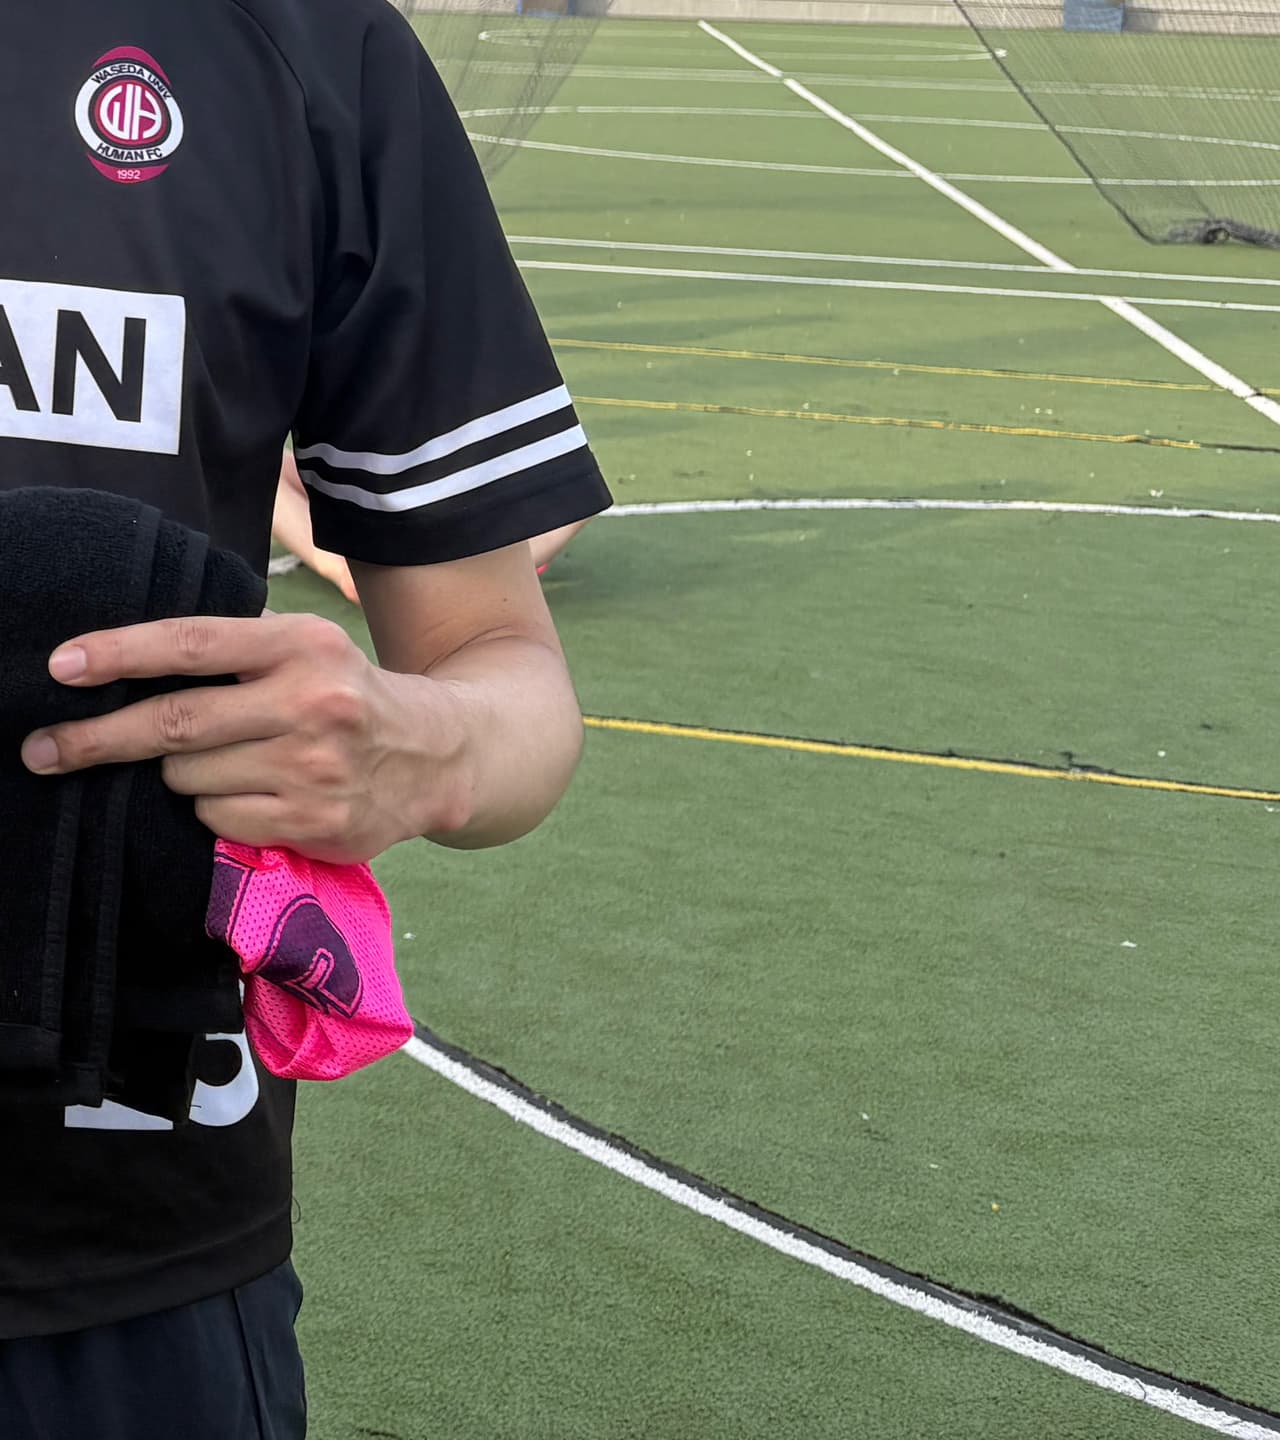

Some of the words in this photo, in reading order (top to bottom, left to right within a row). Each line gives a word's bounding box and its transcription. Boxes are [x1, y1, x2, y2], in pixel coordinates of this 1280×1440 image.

[91, 63, 145, 85] WASEDA
[95, 142, 145, 161] HUMAN
[146, 147, 163, 160] FC
[116, 169, 141, 180] 1992
